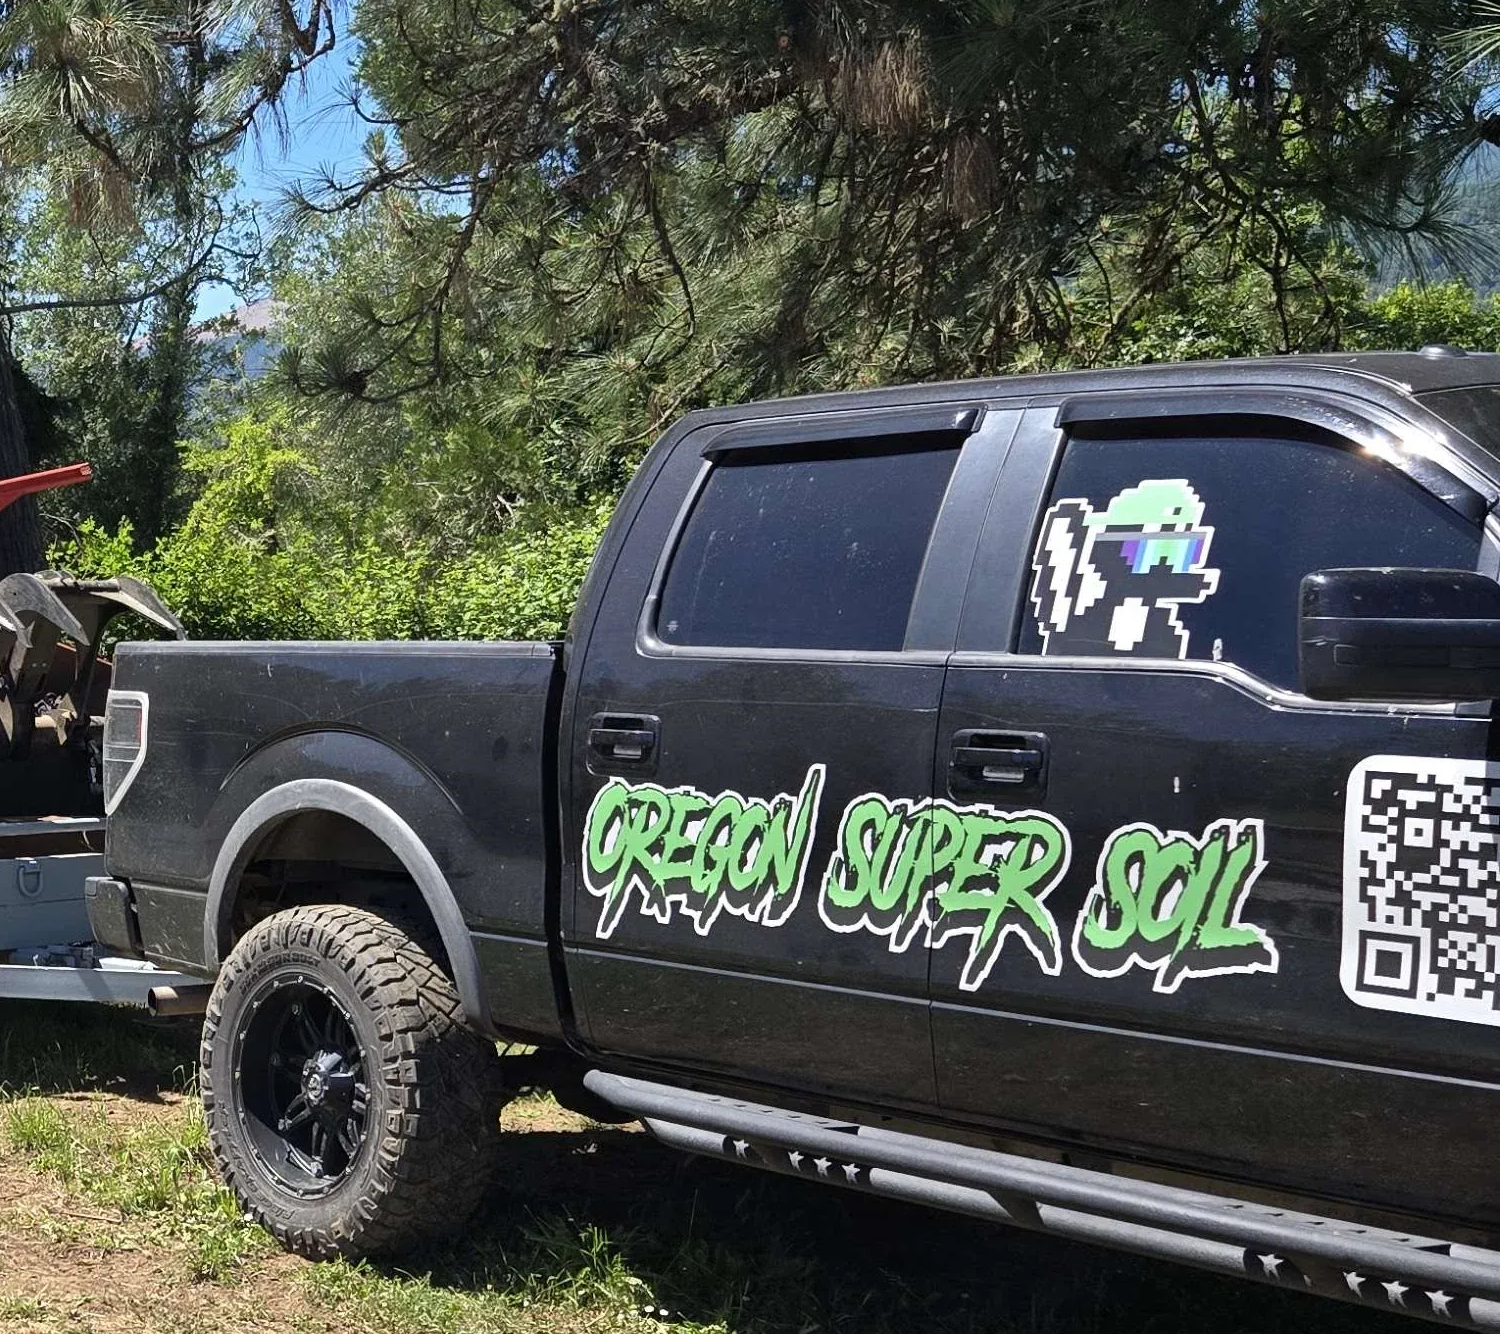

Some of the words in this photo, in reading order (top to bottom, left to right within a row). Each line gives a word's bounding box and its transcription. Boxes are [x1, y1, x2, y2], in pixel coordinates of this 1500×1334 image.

[583, 763, 825, 938] OREGON
[818, 794, 1071, 991] SUPER
[1072, 818, 1279, 993] SOIL
